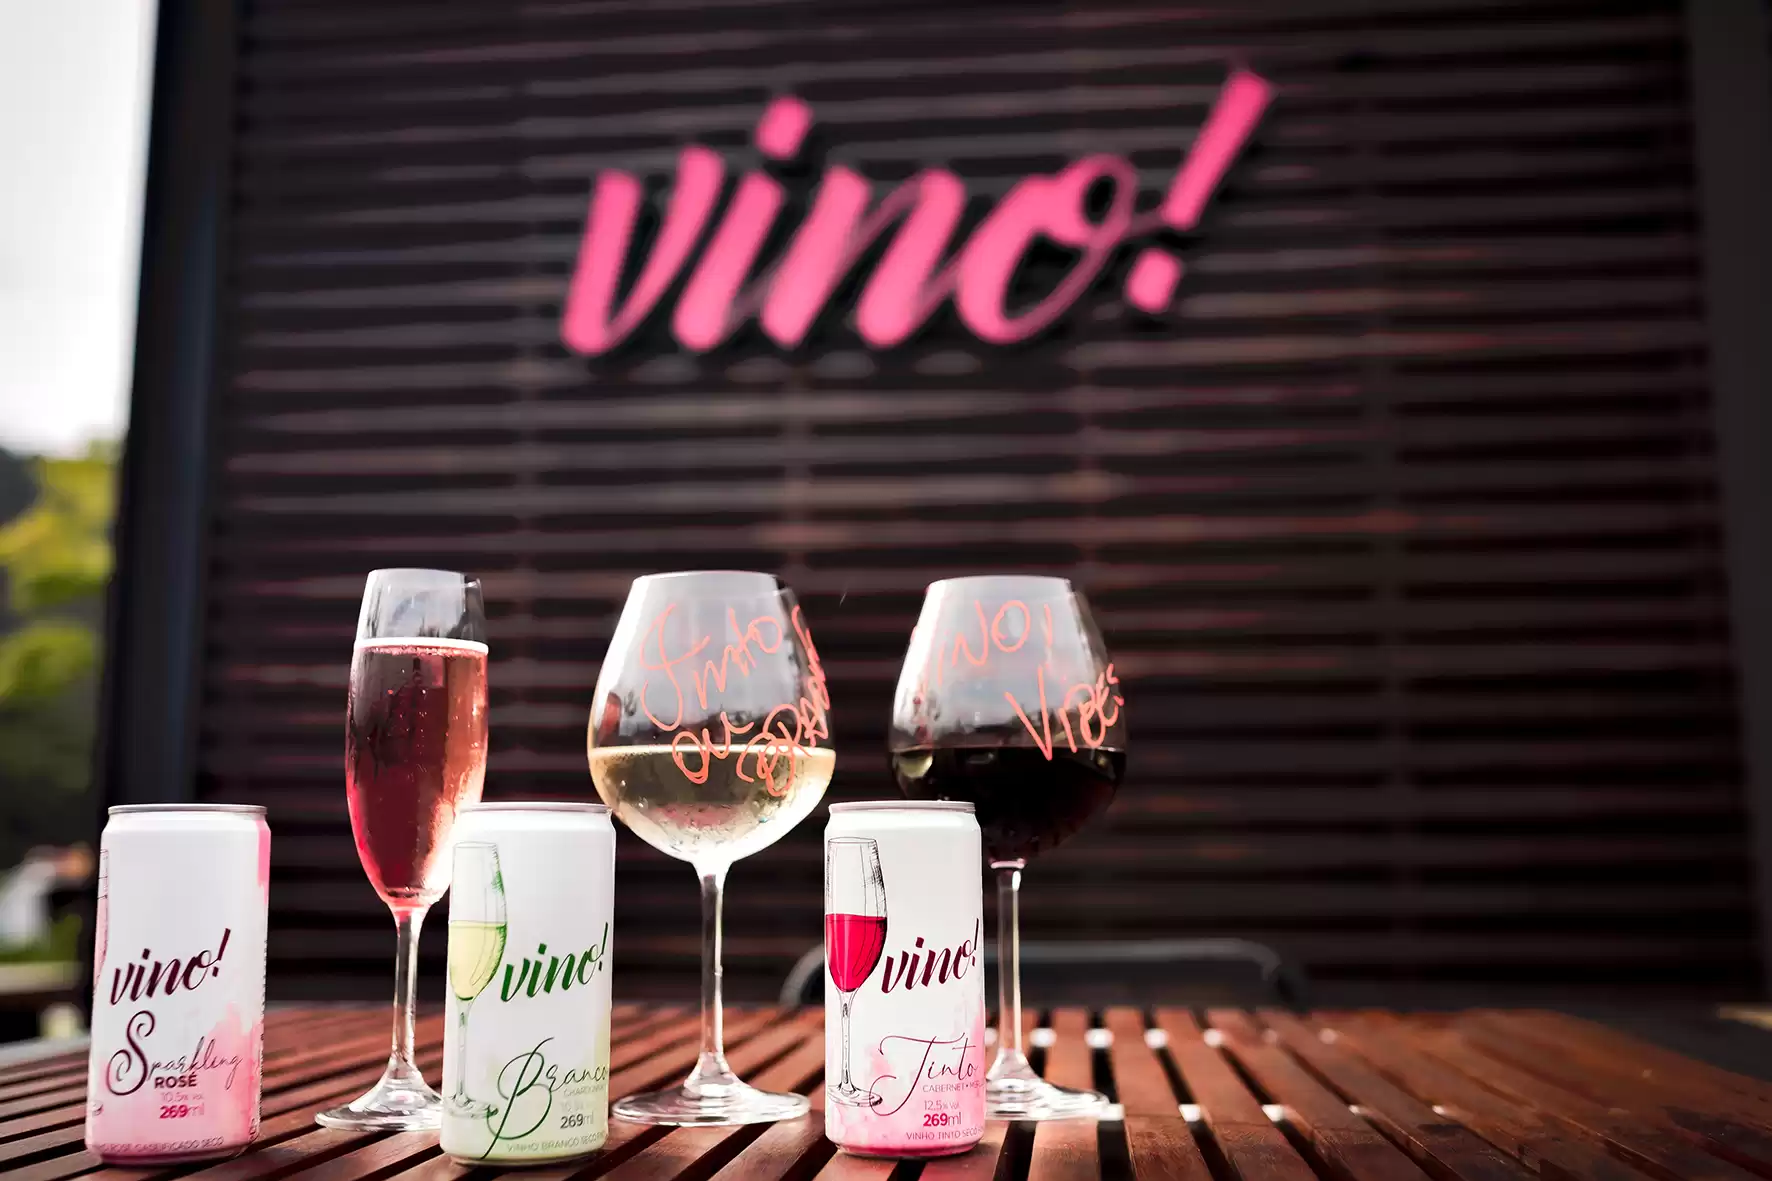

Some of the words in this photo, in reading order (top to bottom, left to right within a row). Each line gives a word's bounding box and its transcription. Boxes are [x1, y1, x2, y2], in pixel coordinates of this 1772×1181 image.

[561, 70, 1270, 355] vino!
[109, 927, 231, 1006] vino!
[500, 921, 609, 1002] vino!
[881, 917, 980, 994] vino!
[105, 1010, 244, 1097] Sparkling
[154, 1073, 198, 1090] ROSÉ
[868, 1032, 979, 1117] Tinto
[922, 1111, 962, 1127] 269ml
